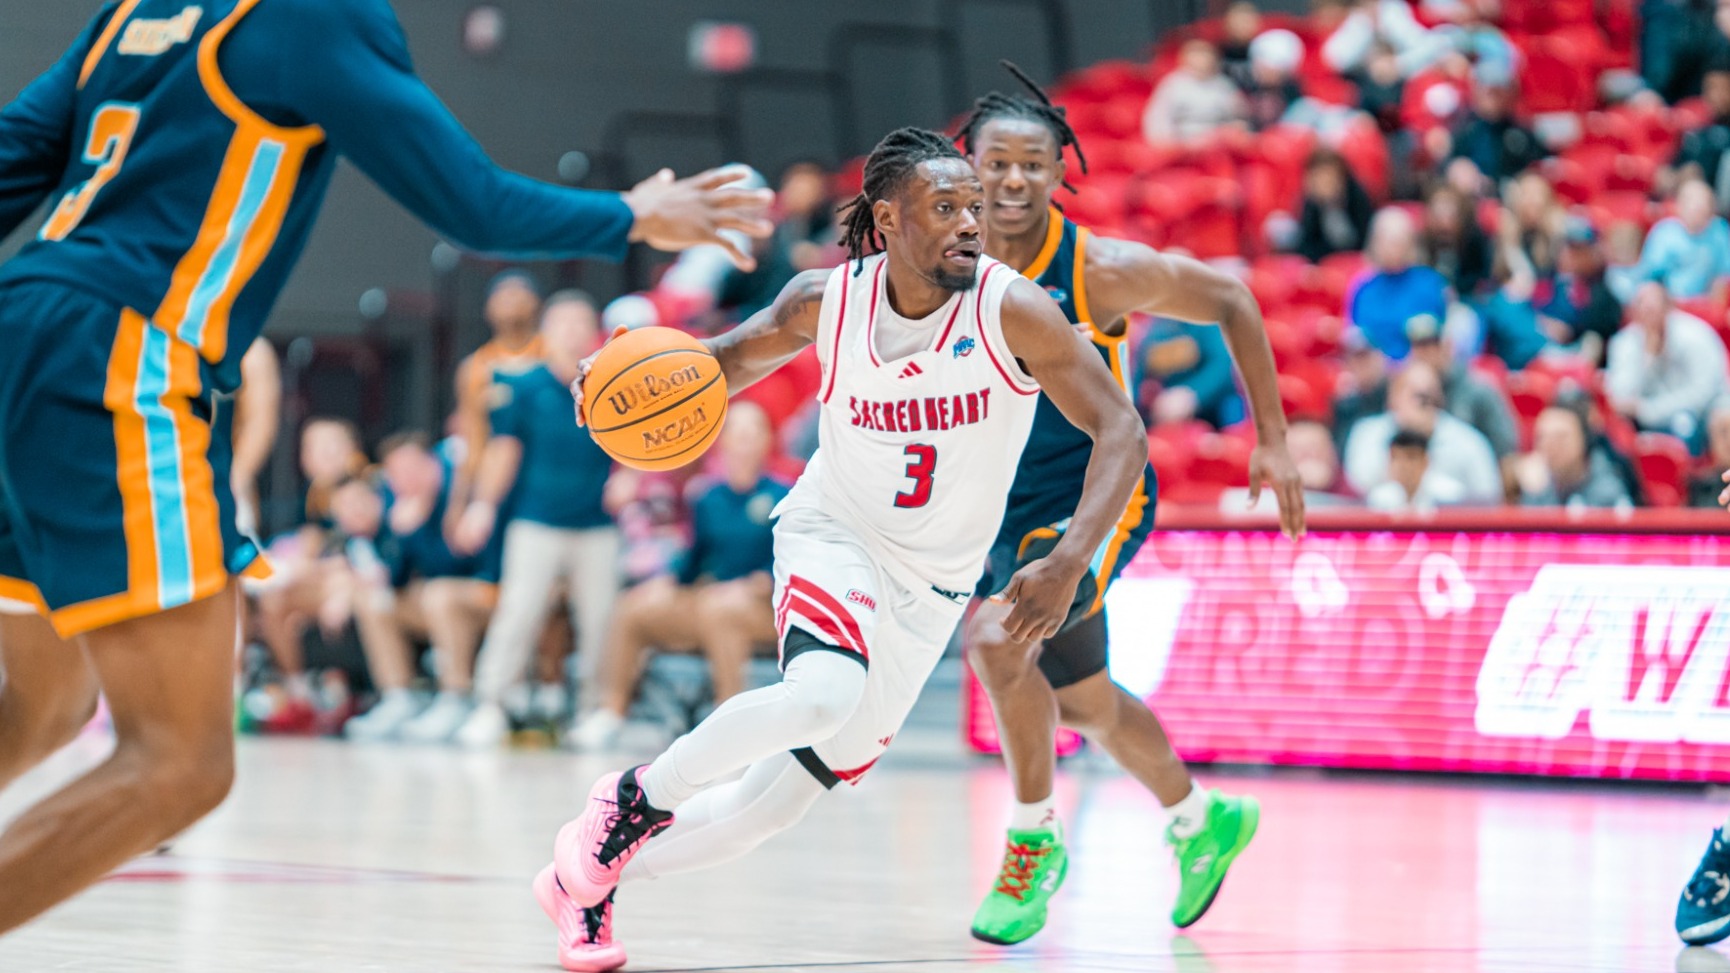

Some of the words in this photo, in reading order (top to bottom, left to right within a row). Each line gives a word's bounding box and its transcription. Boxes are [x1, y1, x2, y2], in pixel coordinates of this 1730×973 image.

[608, 364, 702, 416] Wilson
[849, 395, 922, 433] SACRED
[923, 386, 991, 431] HEART
[642, 405, 707, 449] NCAA
[893, 443, 938, 509] 3
